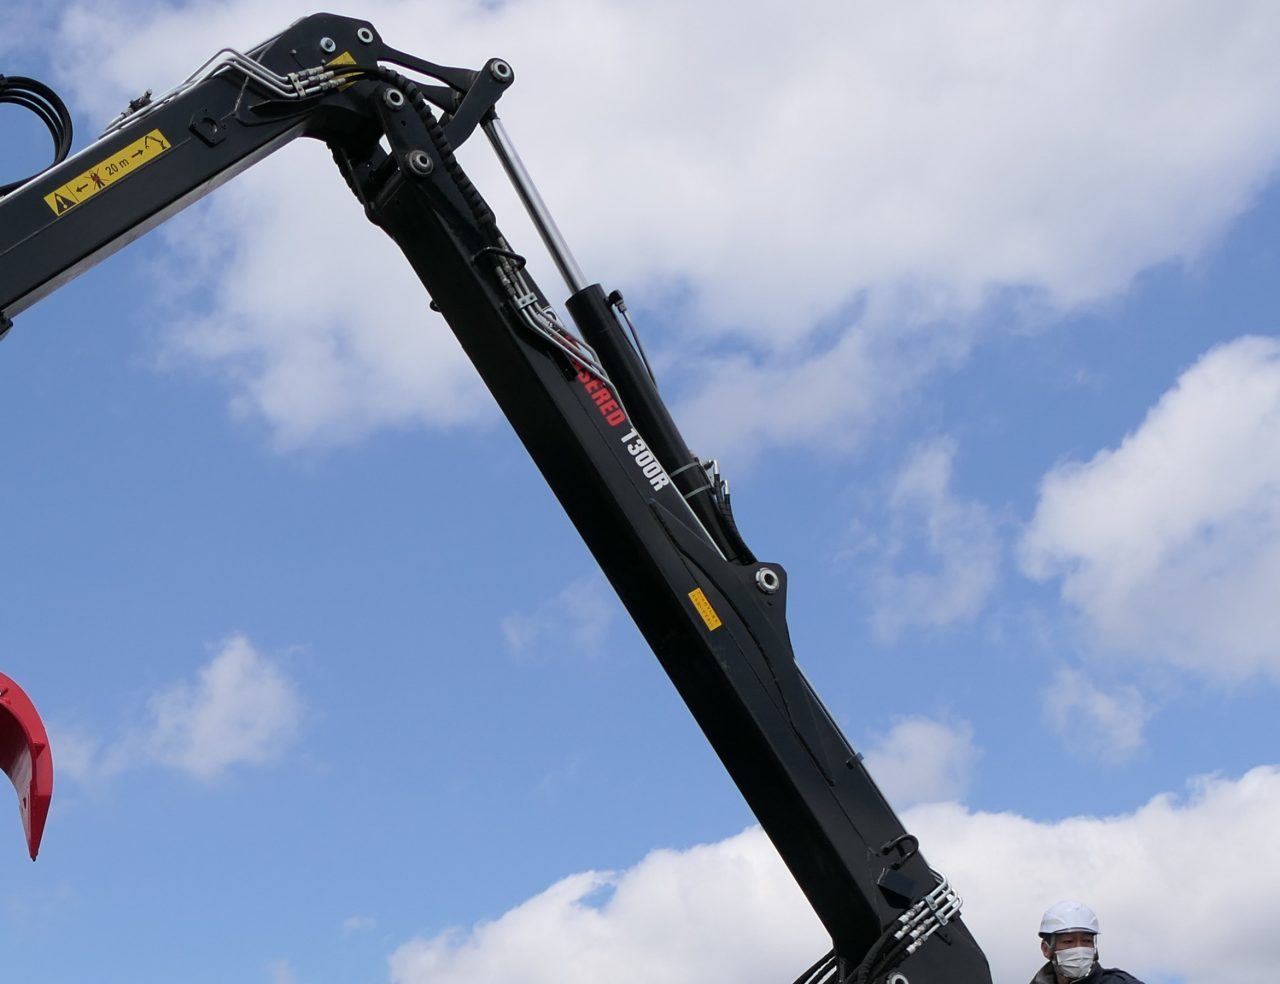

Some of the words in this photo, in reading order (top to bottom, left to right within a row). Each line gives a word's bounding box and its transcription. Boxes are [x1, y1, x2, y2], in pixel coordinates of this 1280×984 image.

[105, 164, 118, 176] 20
[119, 159, 129, 168] m
[620, 428, 670, 492] 1300R
